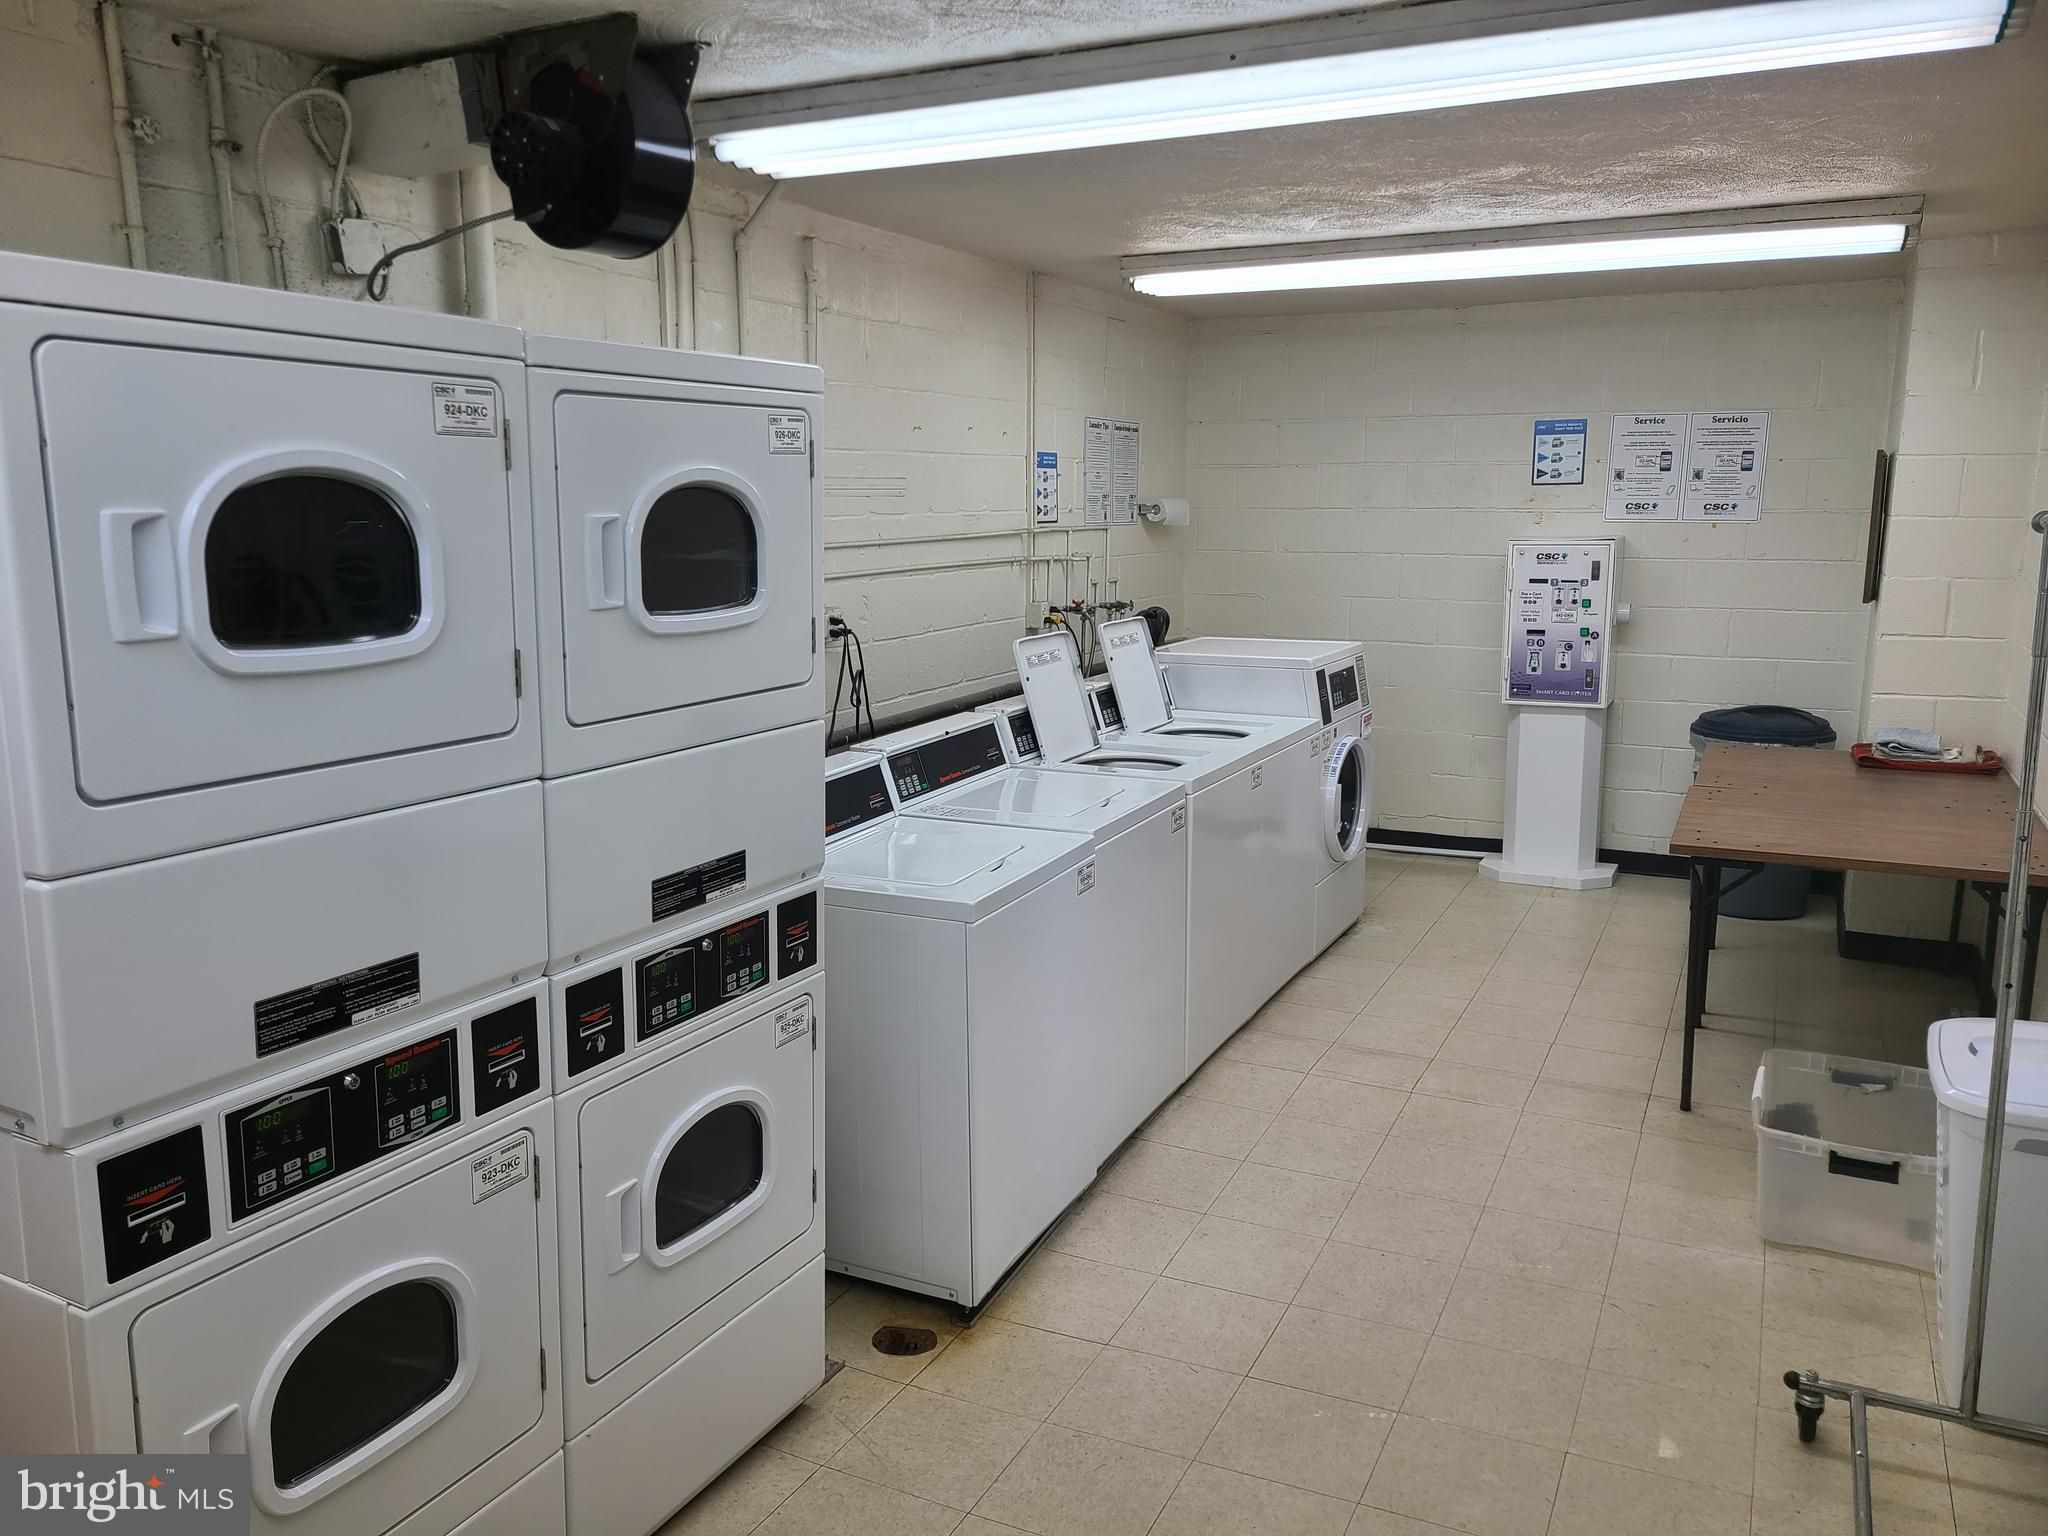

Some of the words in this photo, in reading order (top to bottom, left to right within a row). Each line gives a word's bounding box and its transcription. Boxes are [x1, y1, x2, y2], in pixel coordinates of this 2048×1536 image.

[444, 404, 488, 417] 924-DKC
[1634, 416, 1666, 424] Service
[1712, 415, 1748, 424] Servicio
[774, 430, 800, 439] 926-DKC
[474, 1158, 488, 1168] CSC
[482, 1156, 520, 1182] 923-DKC
[126, 1189, 148, 1201] INSERT
[148, 1182, 166, 1193] CARD
[166, 1175, 182, 1186] HERE
